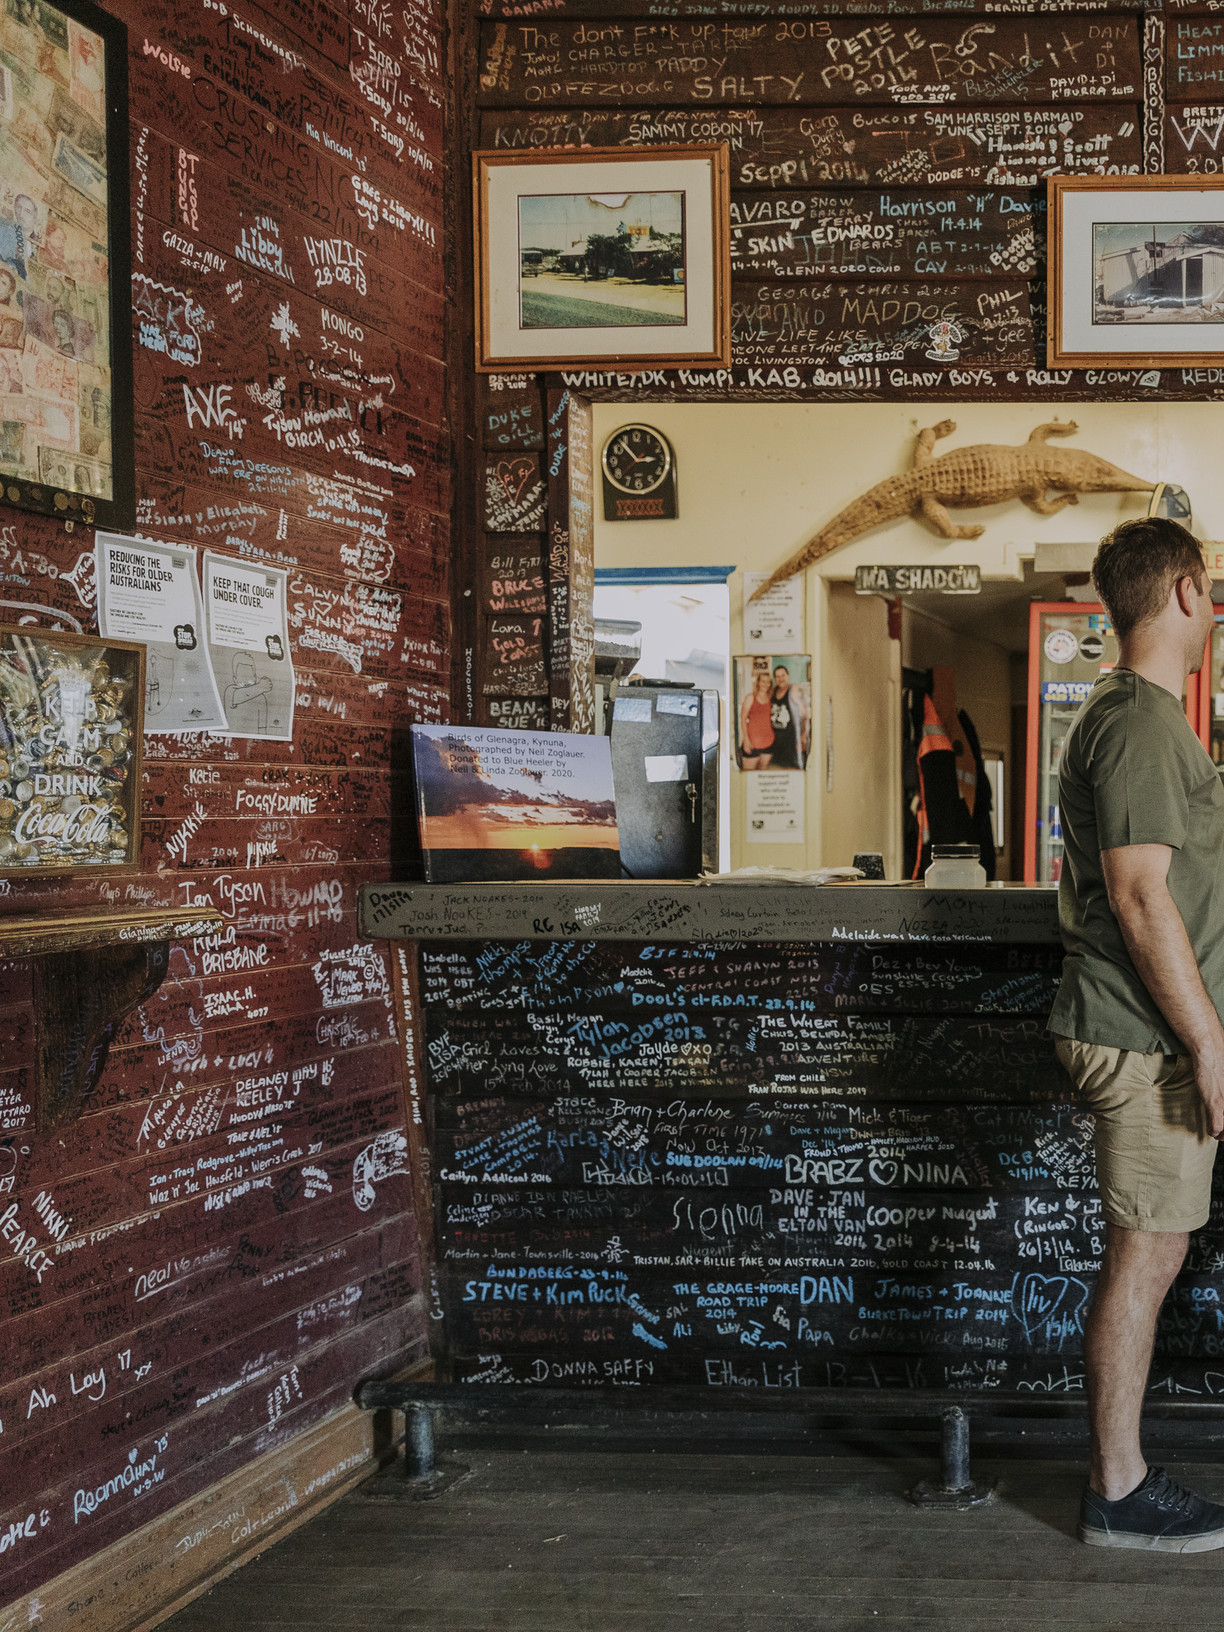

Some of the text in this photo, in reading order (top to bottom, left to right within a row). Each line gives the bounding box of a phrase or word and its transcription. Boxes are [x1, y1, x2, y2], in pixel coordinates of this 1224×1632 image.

[519, 21, 832, 49] The up 2013
[690, 72, 805, 100] SALTY
[924, 111, 1084, 127] SAM HARRISON BARMAID
[628, 122, 743, 141] SAMMY COBON
[1025, 123, 1058, 135] 2016
[879, 195, 957, 217] Harrison
[811, 225, 895, 245] EDWARDS
[774, 264, 867, 276] GLENN 2020
[321, 307, 364, 342] MONGO
[182, 383, 237, 429] AXE
[110, 550, 161, 569] REDUCING THE
[110, 563, 173, 582] RISKS FOR OLDER
[861, 567, 979, 591] MA SHADOW
[110, 574, 161, 592] AUSTRALIANS
[213, 576, 274, 599] KEEP THAT COUGH
[213, 589, 263, 609] UNDER COVER.
[40, 725, 100, 747] CALM
[448, 733, 471, 741] Birds
[487, 735, 529, 745] Glenagra,
[532, 738, 566, 748] Kynuna,
[56, 754, 83, 767] AND
[448, 744, 585, 758] Photographed by Neil Zoglauer.
[450, 755, 566, 768] Donated to Blue Heeler by
[482, 766, 505, 774] Linda
[552, 769, 575, 778] 2020.
[35, 774, 102, 796] DRINK
[831, 927, 931, 942] Adelaide here
[757, 1013, 892, 1032] THE WHEAT FAMILY
[797, 1054, 879, 1065] ADVENTURE
[235, 1072, 289, 1092] DELANEY
[530, 1173, 552, 1183] 2016
[785, 1154, 969, 1185] BRABZ NINA
[778, 1219, 866, 1232] ELTON VAN
[462, 1280, 584, 1305] STEVE Kim
[799, 1276, 854, 1305] DAN
[874, 1278, 933, 1299] JAMES
[531, 1358, 654, 1381] DONNA SAFFY
